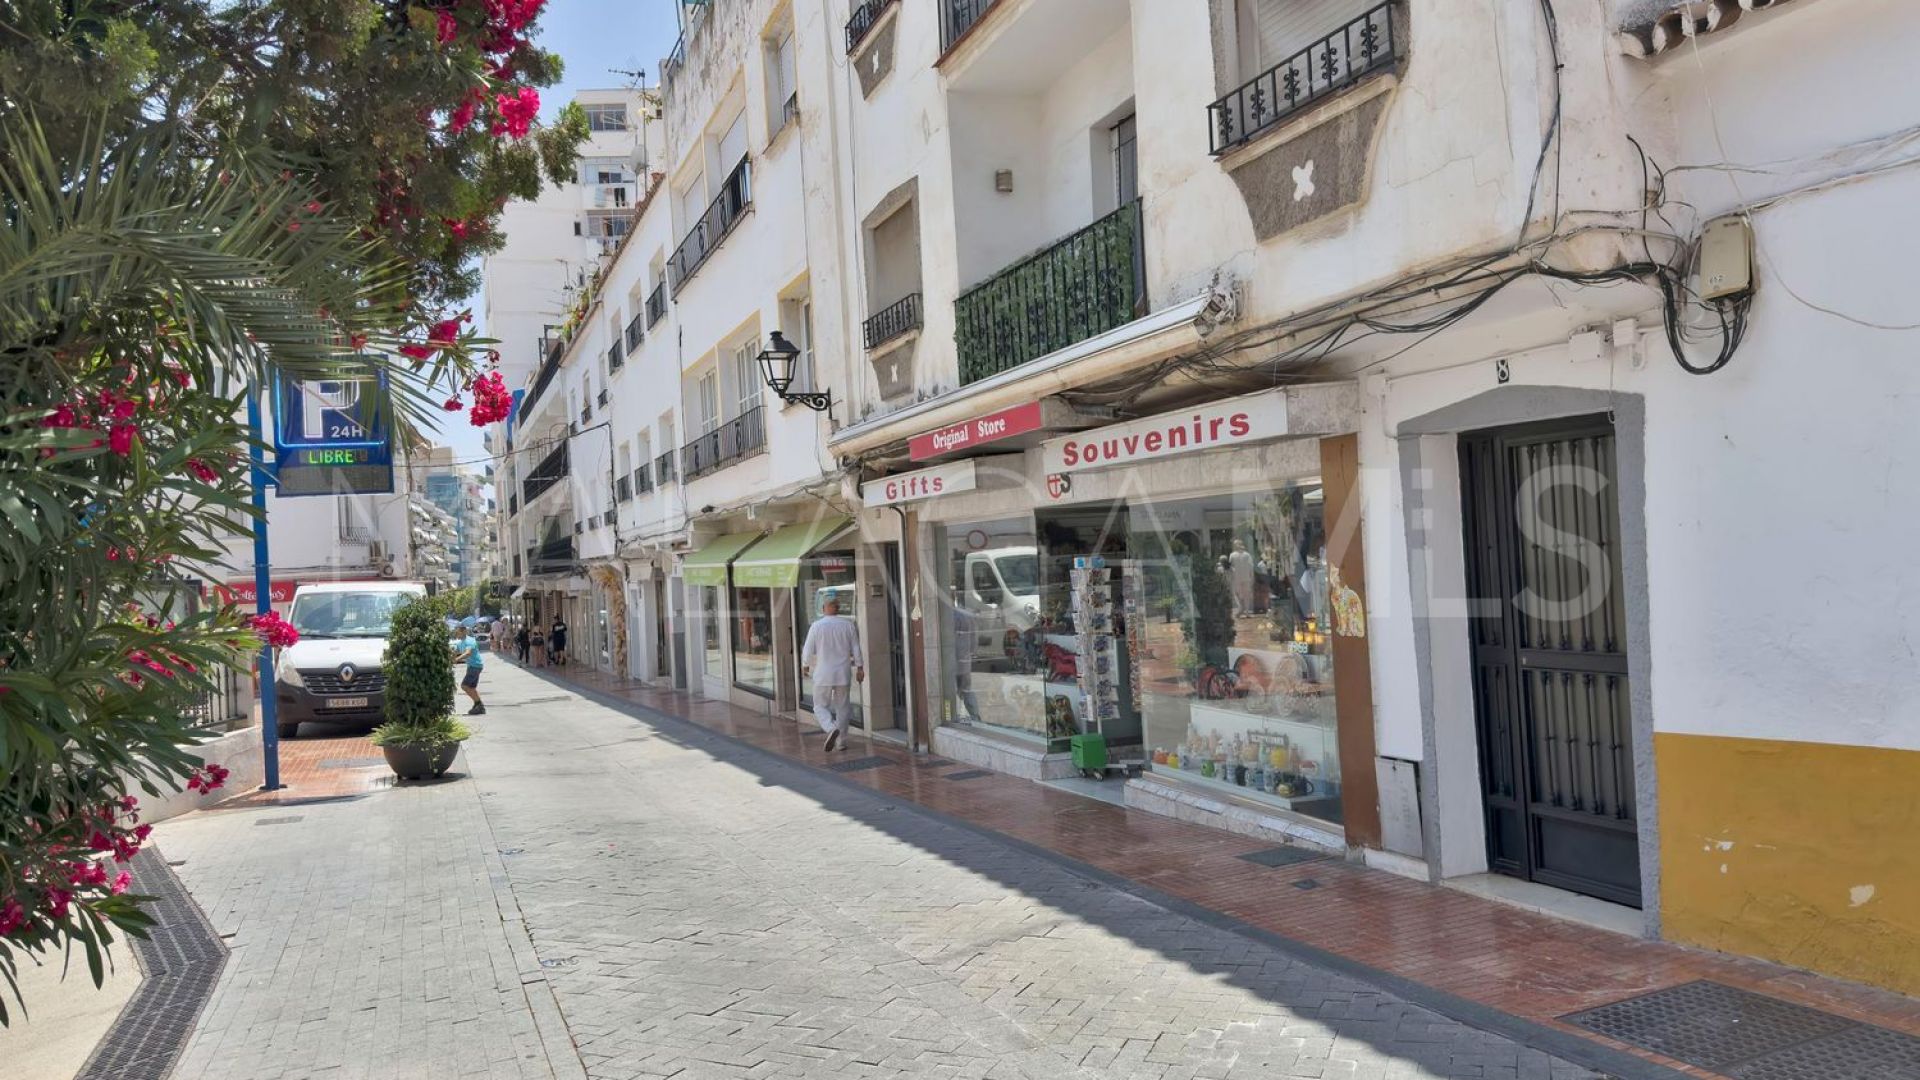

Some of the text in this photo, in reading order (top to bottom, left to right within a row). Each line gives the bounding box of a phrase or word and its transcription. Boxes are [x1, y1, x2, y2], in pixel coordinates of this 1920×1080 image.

[302, 377, 360, 439] P
[330, 425, 363, 438] 24H
[932, 418, 1006, 449] Original Store
[1062, 412, 1250, 466] Souvenirs
[309, 449, 354, 464] LIBRE
[885, 475, 943, 500] Gifts
